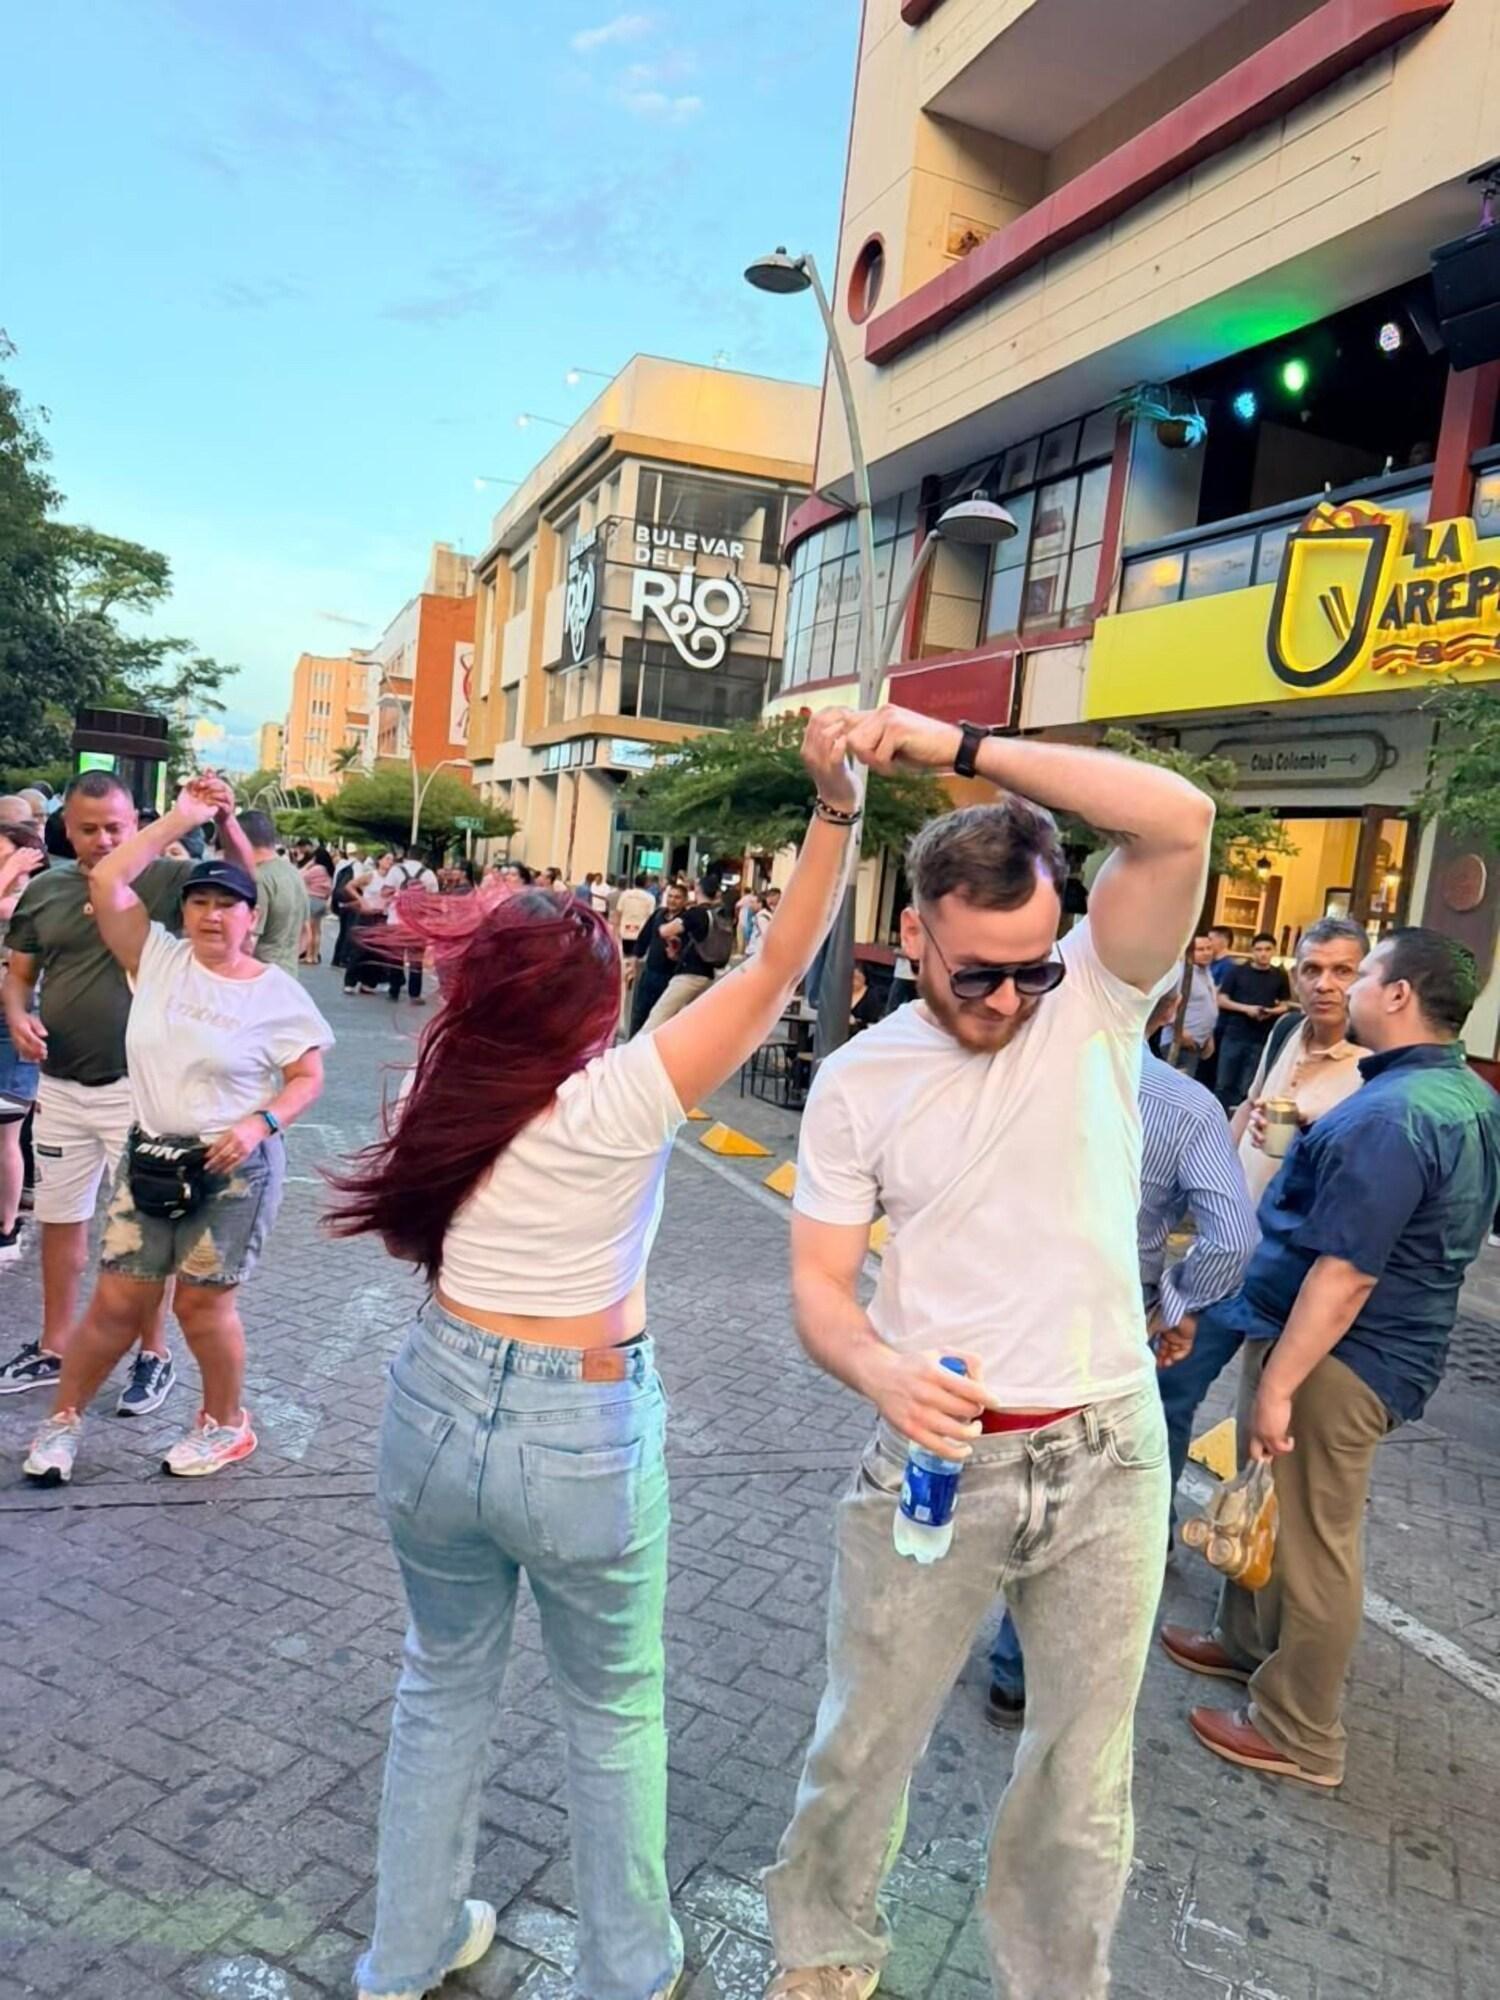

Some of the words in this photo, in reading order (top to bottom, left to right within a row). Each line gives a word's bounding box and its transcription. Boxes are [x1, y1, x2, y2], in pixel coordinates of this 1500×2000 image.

[635, 525, 745, 560] BULEVAR
[635, 546, 681, 569] DEL
[1411, 523, 1463, 569] LA
[630, 564, 742, 669] RÍO
[1377, 565, 1500, 630] AREP
[1251, 753, 1274, 772] Club
[1276, 752, 1328, 771] Colombia
